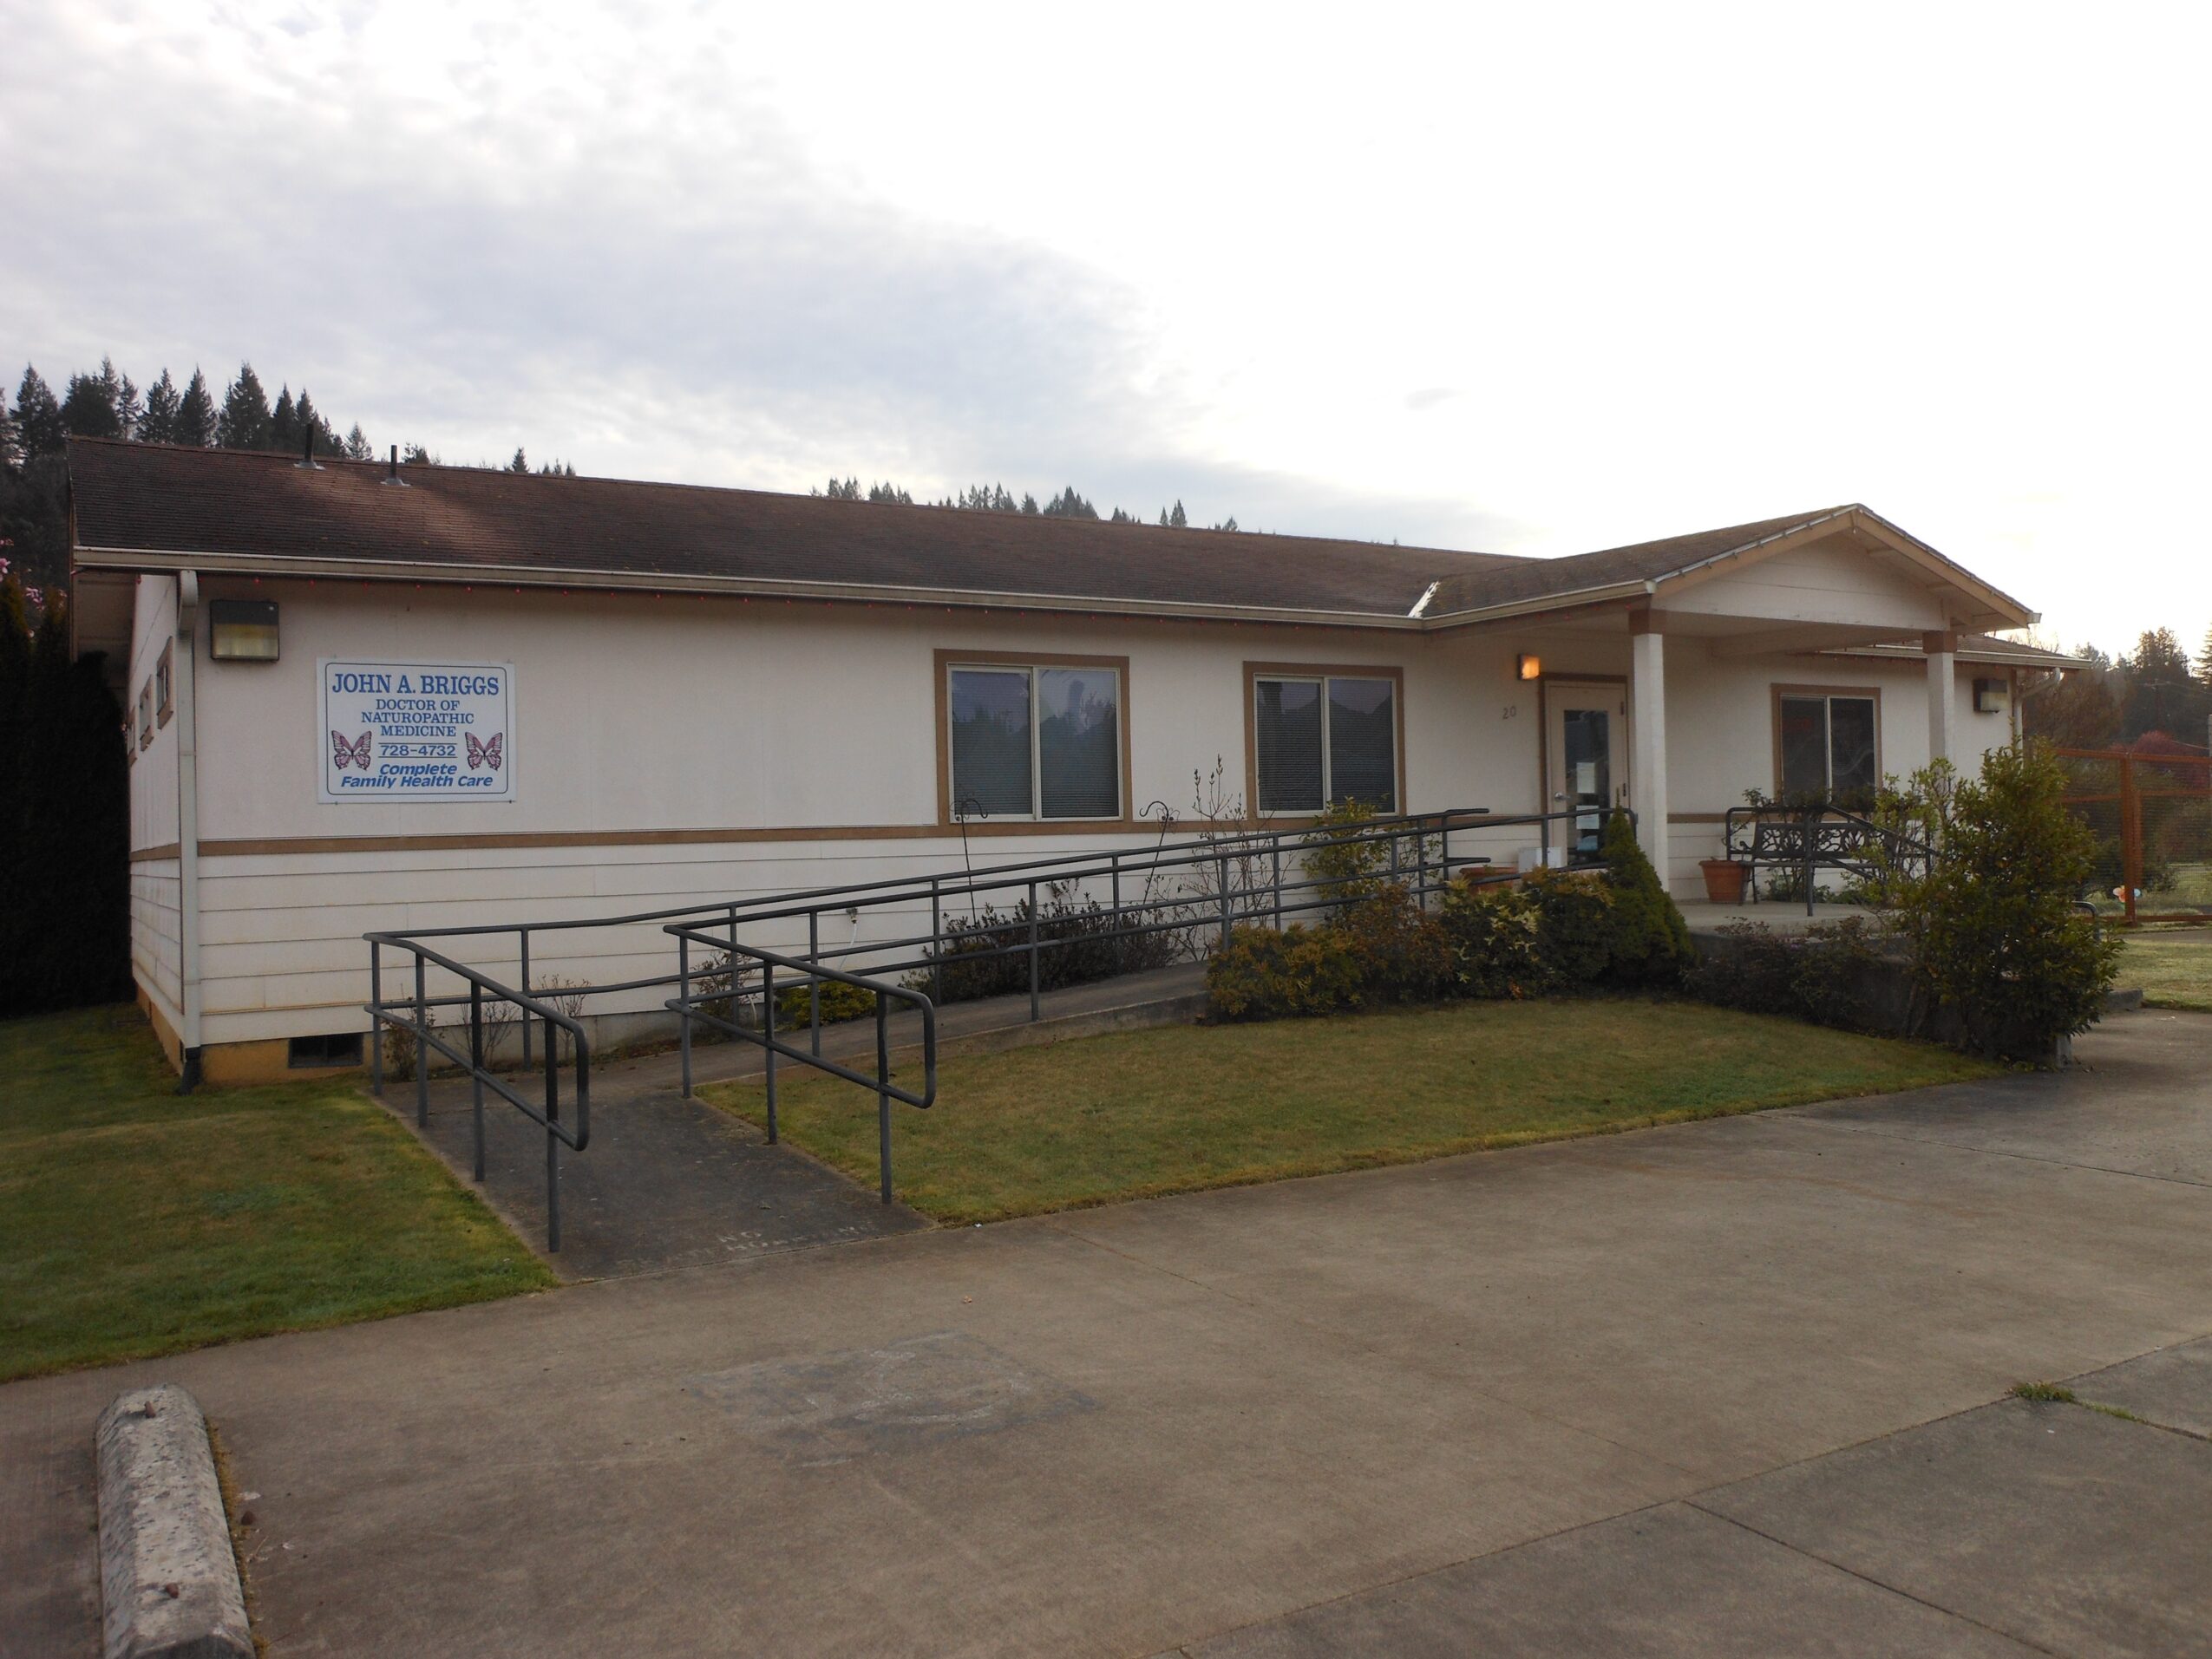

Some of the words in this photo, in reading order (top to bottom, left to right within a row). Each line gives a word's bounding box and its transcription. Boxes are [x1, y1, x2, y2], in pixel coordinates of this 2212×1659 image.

[332, 674, 391, 694] JOHN
[397, 675, 416, 694] A.
[421, 676, 499, 696] BRIGGS
[376, 699, 435, 711] DOCTOR
[440, 700, 460, 711] OF
[361, 712, 474, 724] NATUROPATHIC
[1502, 706, 1516, 720] 20
[380, 725, 456, 737] MEDICINE
[381, 745, 455, 756] 728-4732
[380, 763, 457, 777] Complete
[341, 775, 396, 789] Family
[400, 775, 453, 787] Health
[458, 775, 493, 787] Care
